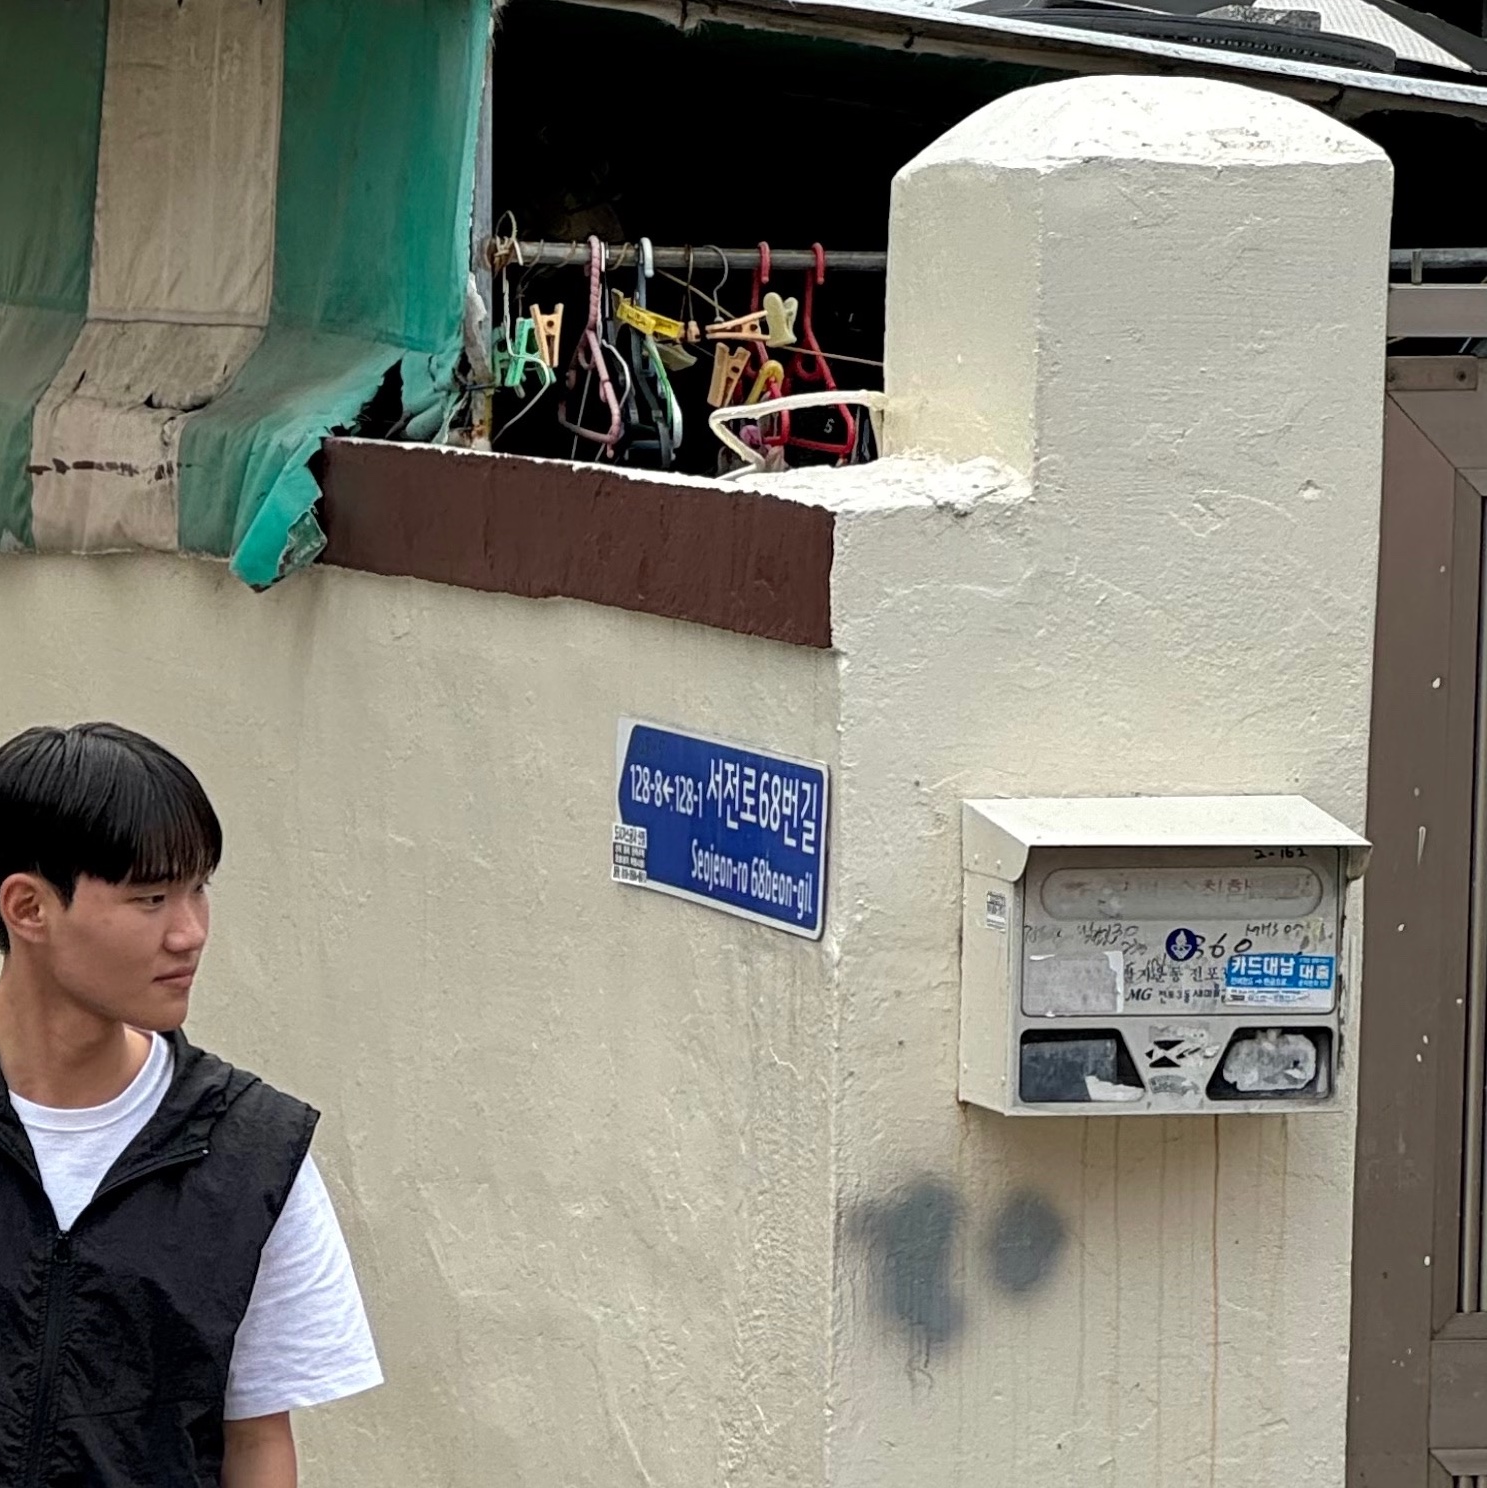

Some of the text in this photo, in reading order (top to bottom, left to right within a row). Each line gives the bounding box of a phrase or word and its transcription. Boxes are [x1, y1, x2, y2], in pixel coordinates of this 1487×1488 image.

[630, 758, 818, 854] 128-8 128-1 서전로68번길
[691, 838, 748, 893] Seojeon-ro
[751, 856, 813, 920] 68beon-gil
[1124, 987, 1154, 1002] MG
[1231, 956, 1330, 980] 카드대납 대출
